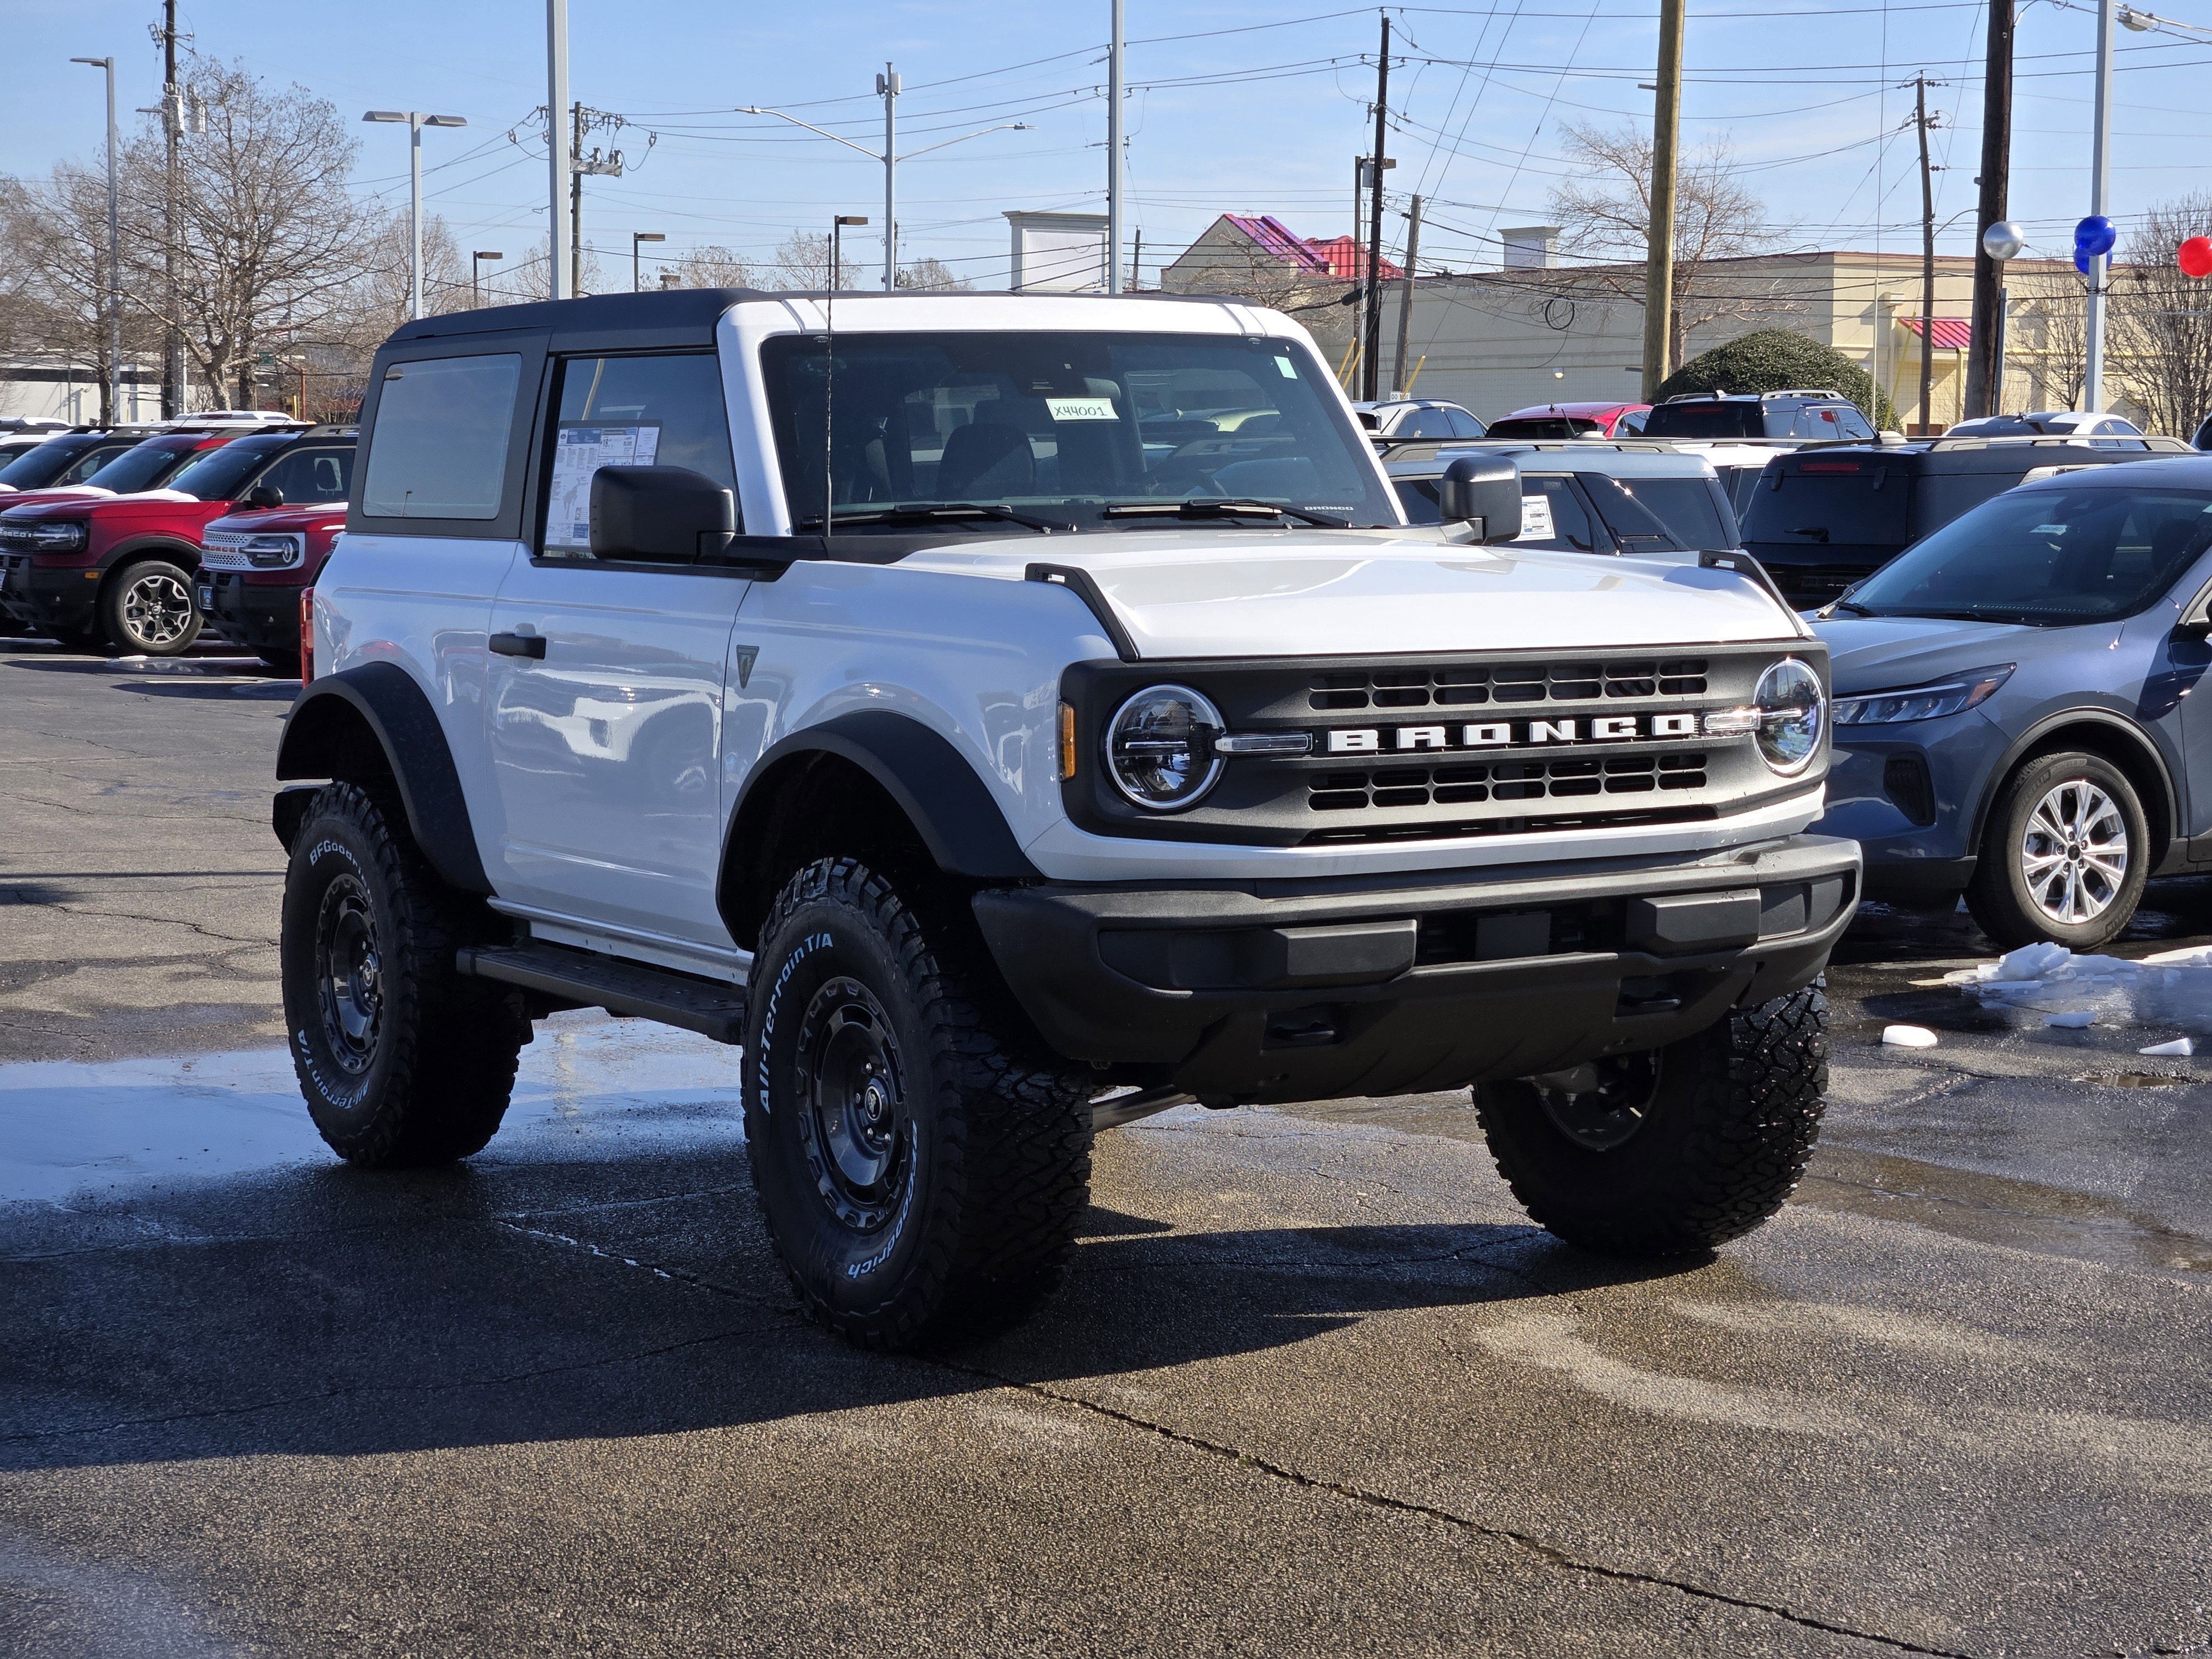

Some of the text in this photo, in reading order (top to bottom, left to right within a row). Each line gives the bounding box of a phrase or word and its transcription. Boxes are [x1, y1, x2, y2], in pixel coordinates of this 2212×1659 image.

[1053, 406, 1108, 416] X44001
[1327, 714, 1695, 752] BRONCO
[758, 933, 833, 1115] All-Terrain T/A
[298, 1029, 314, 1070] T/A
[847, 1119, 919, 1279] BFGoodrich
